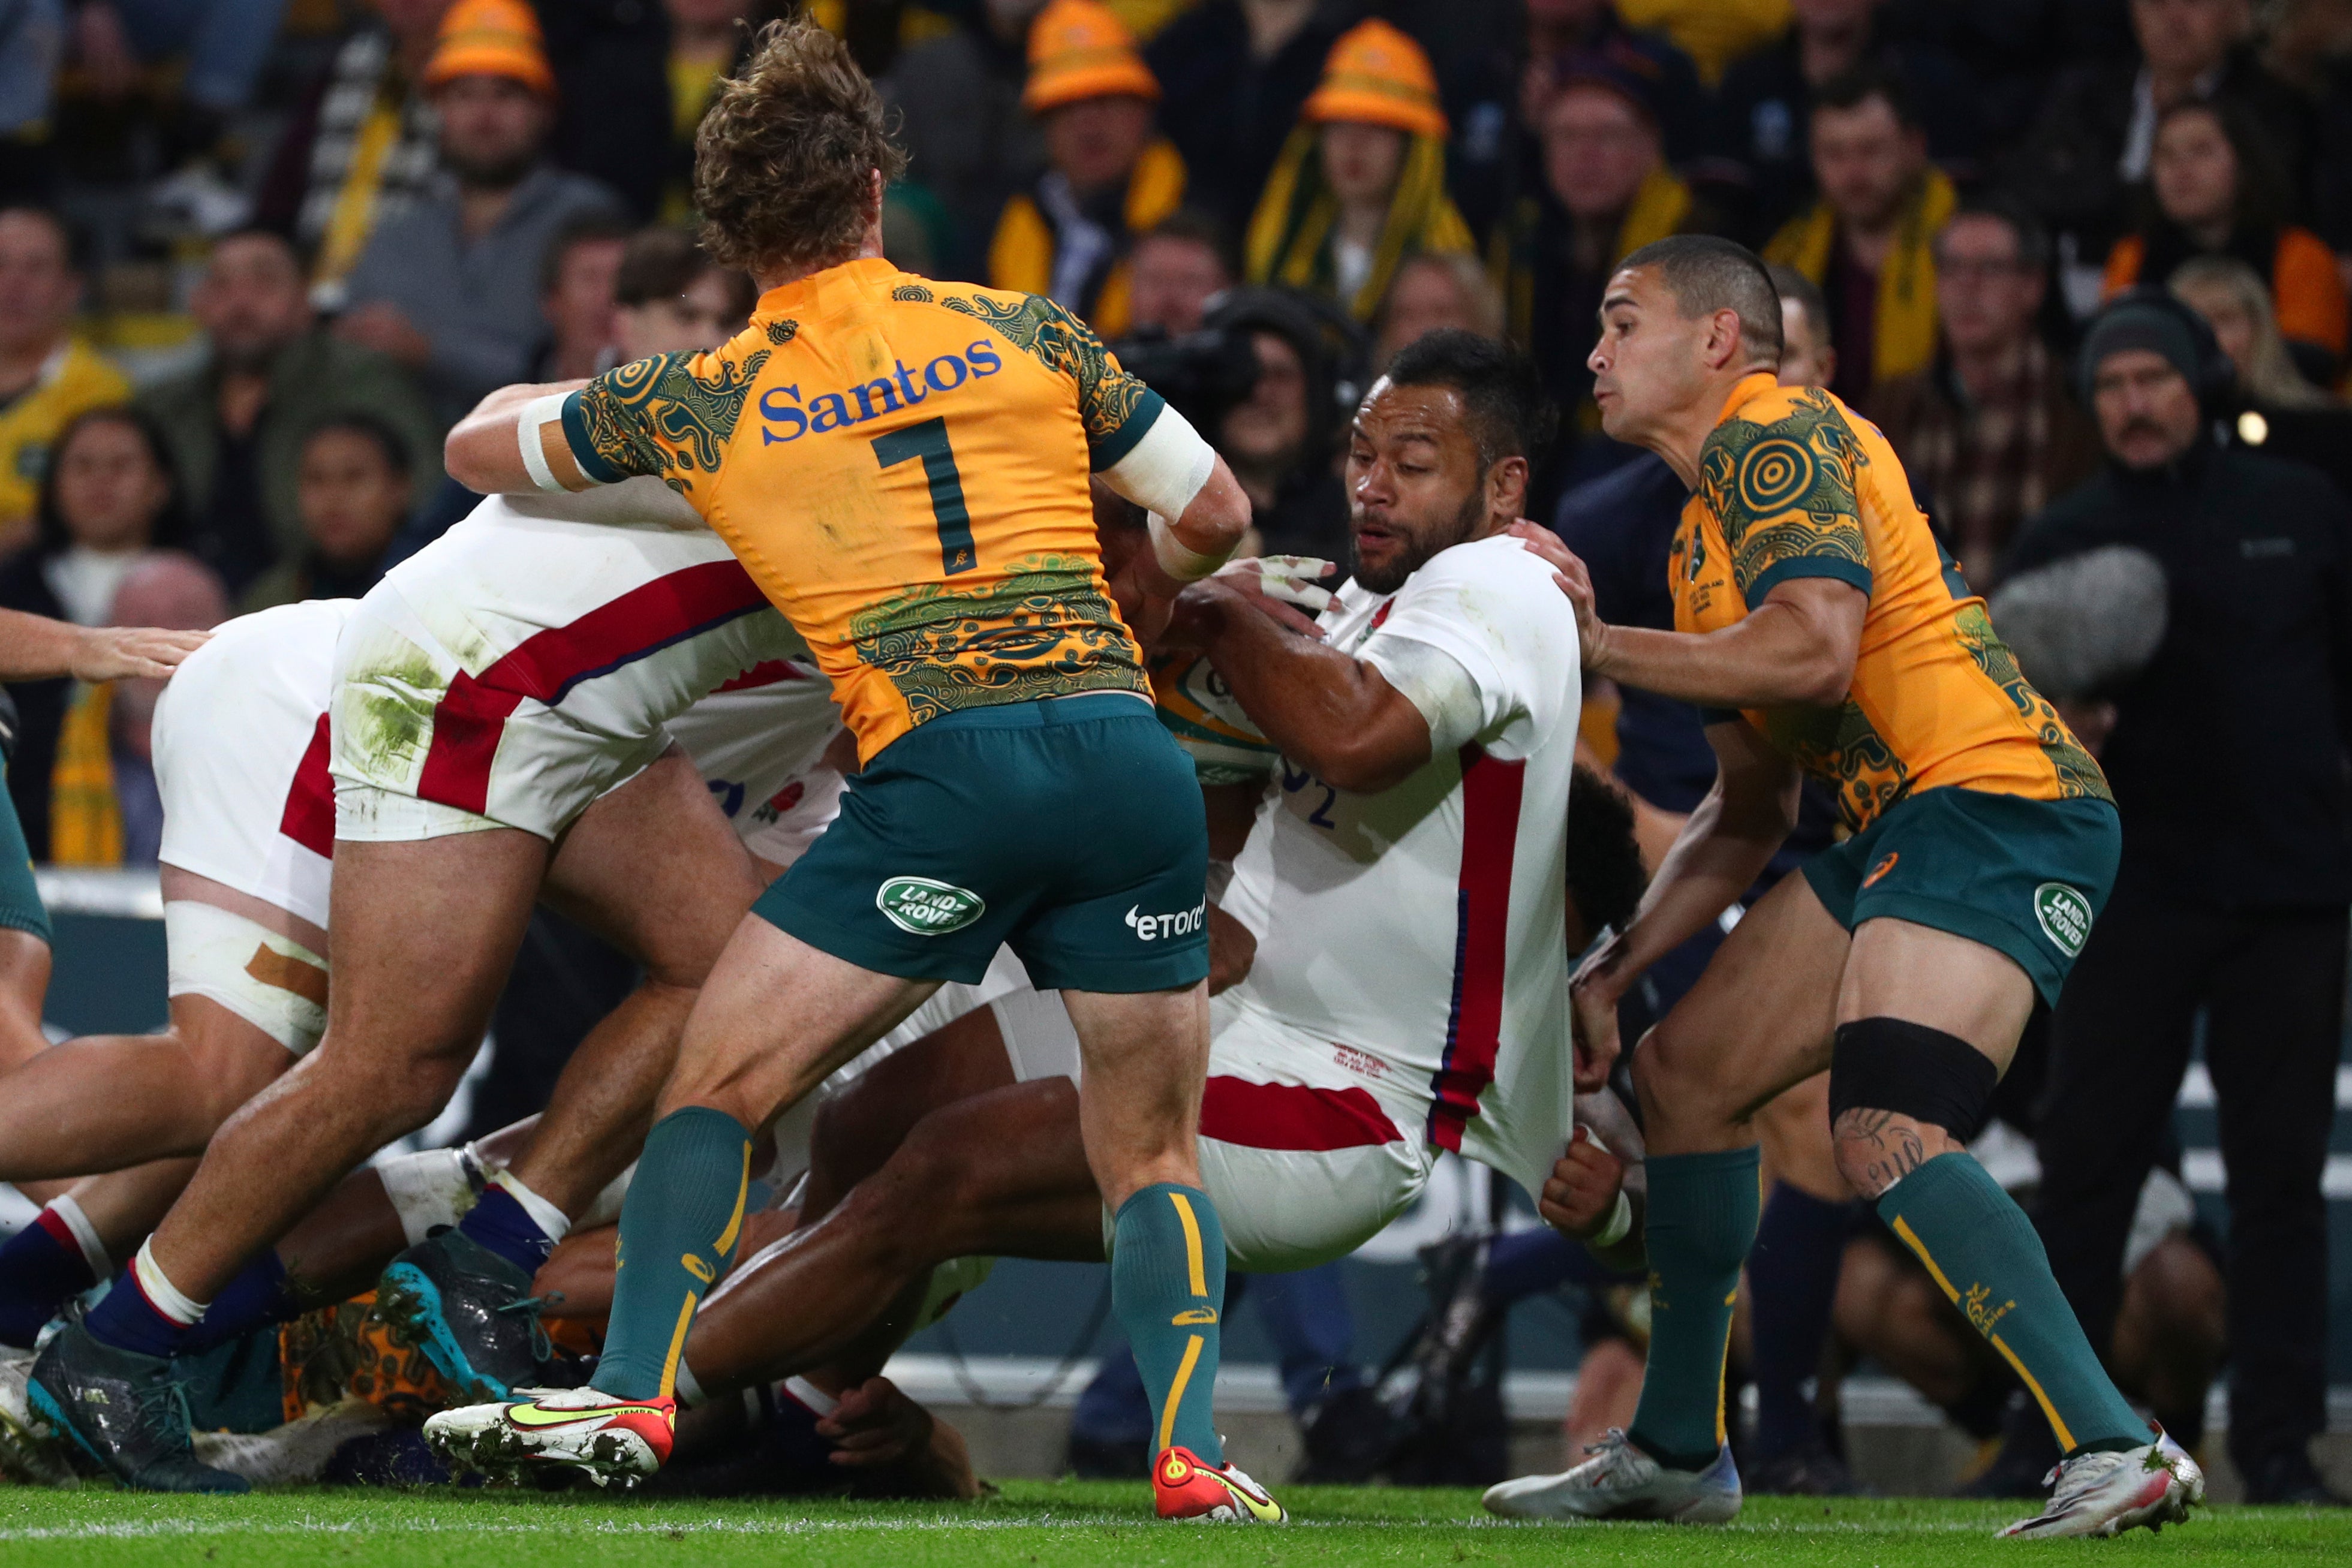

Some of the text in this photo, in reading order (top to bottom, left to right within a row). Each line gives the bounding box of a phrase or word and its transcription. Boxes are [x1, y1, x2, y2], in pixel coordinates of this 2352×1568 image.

[759, 339, 1002, 447] Santos
[870, 416, 978, 576] 7
[898, 902, 963, 925] ROVER
[900, 886, 957, 911] LAND
[2052, 892, 2085, 927] LAND
[2049, 908, 2083, 946] ROVER
